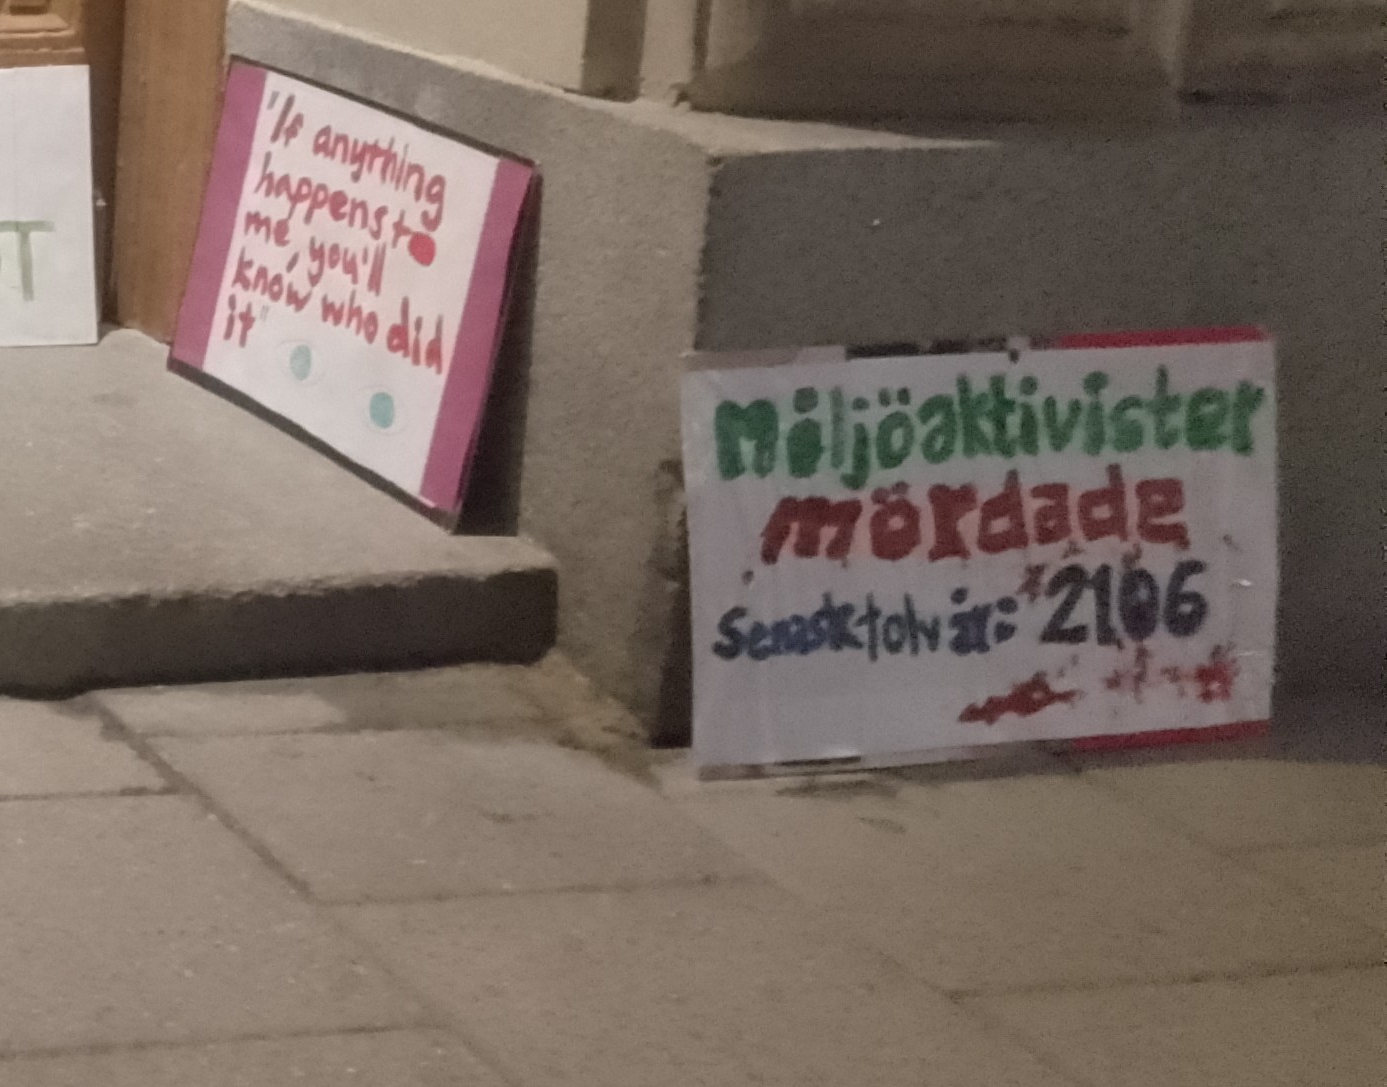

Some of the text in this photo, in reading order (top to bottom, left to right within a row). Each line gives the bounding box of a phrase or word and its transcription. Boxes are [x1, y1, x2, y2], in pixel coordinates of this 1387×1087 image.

[254, 149, 389, 241] happens
[312, 123, 447, 232] anything
[230, 250, 444, 376] know who did
[307, 235, 387, 297] you'll
[759, 463, 1191, 566] mördade
[1039, 559, 1209, 648] 2106
